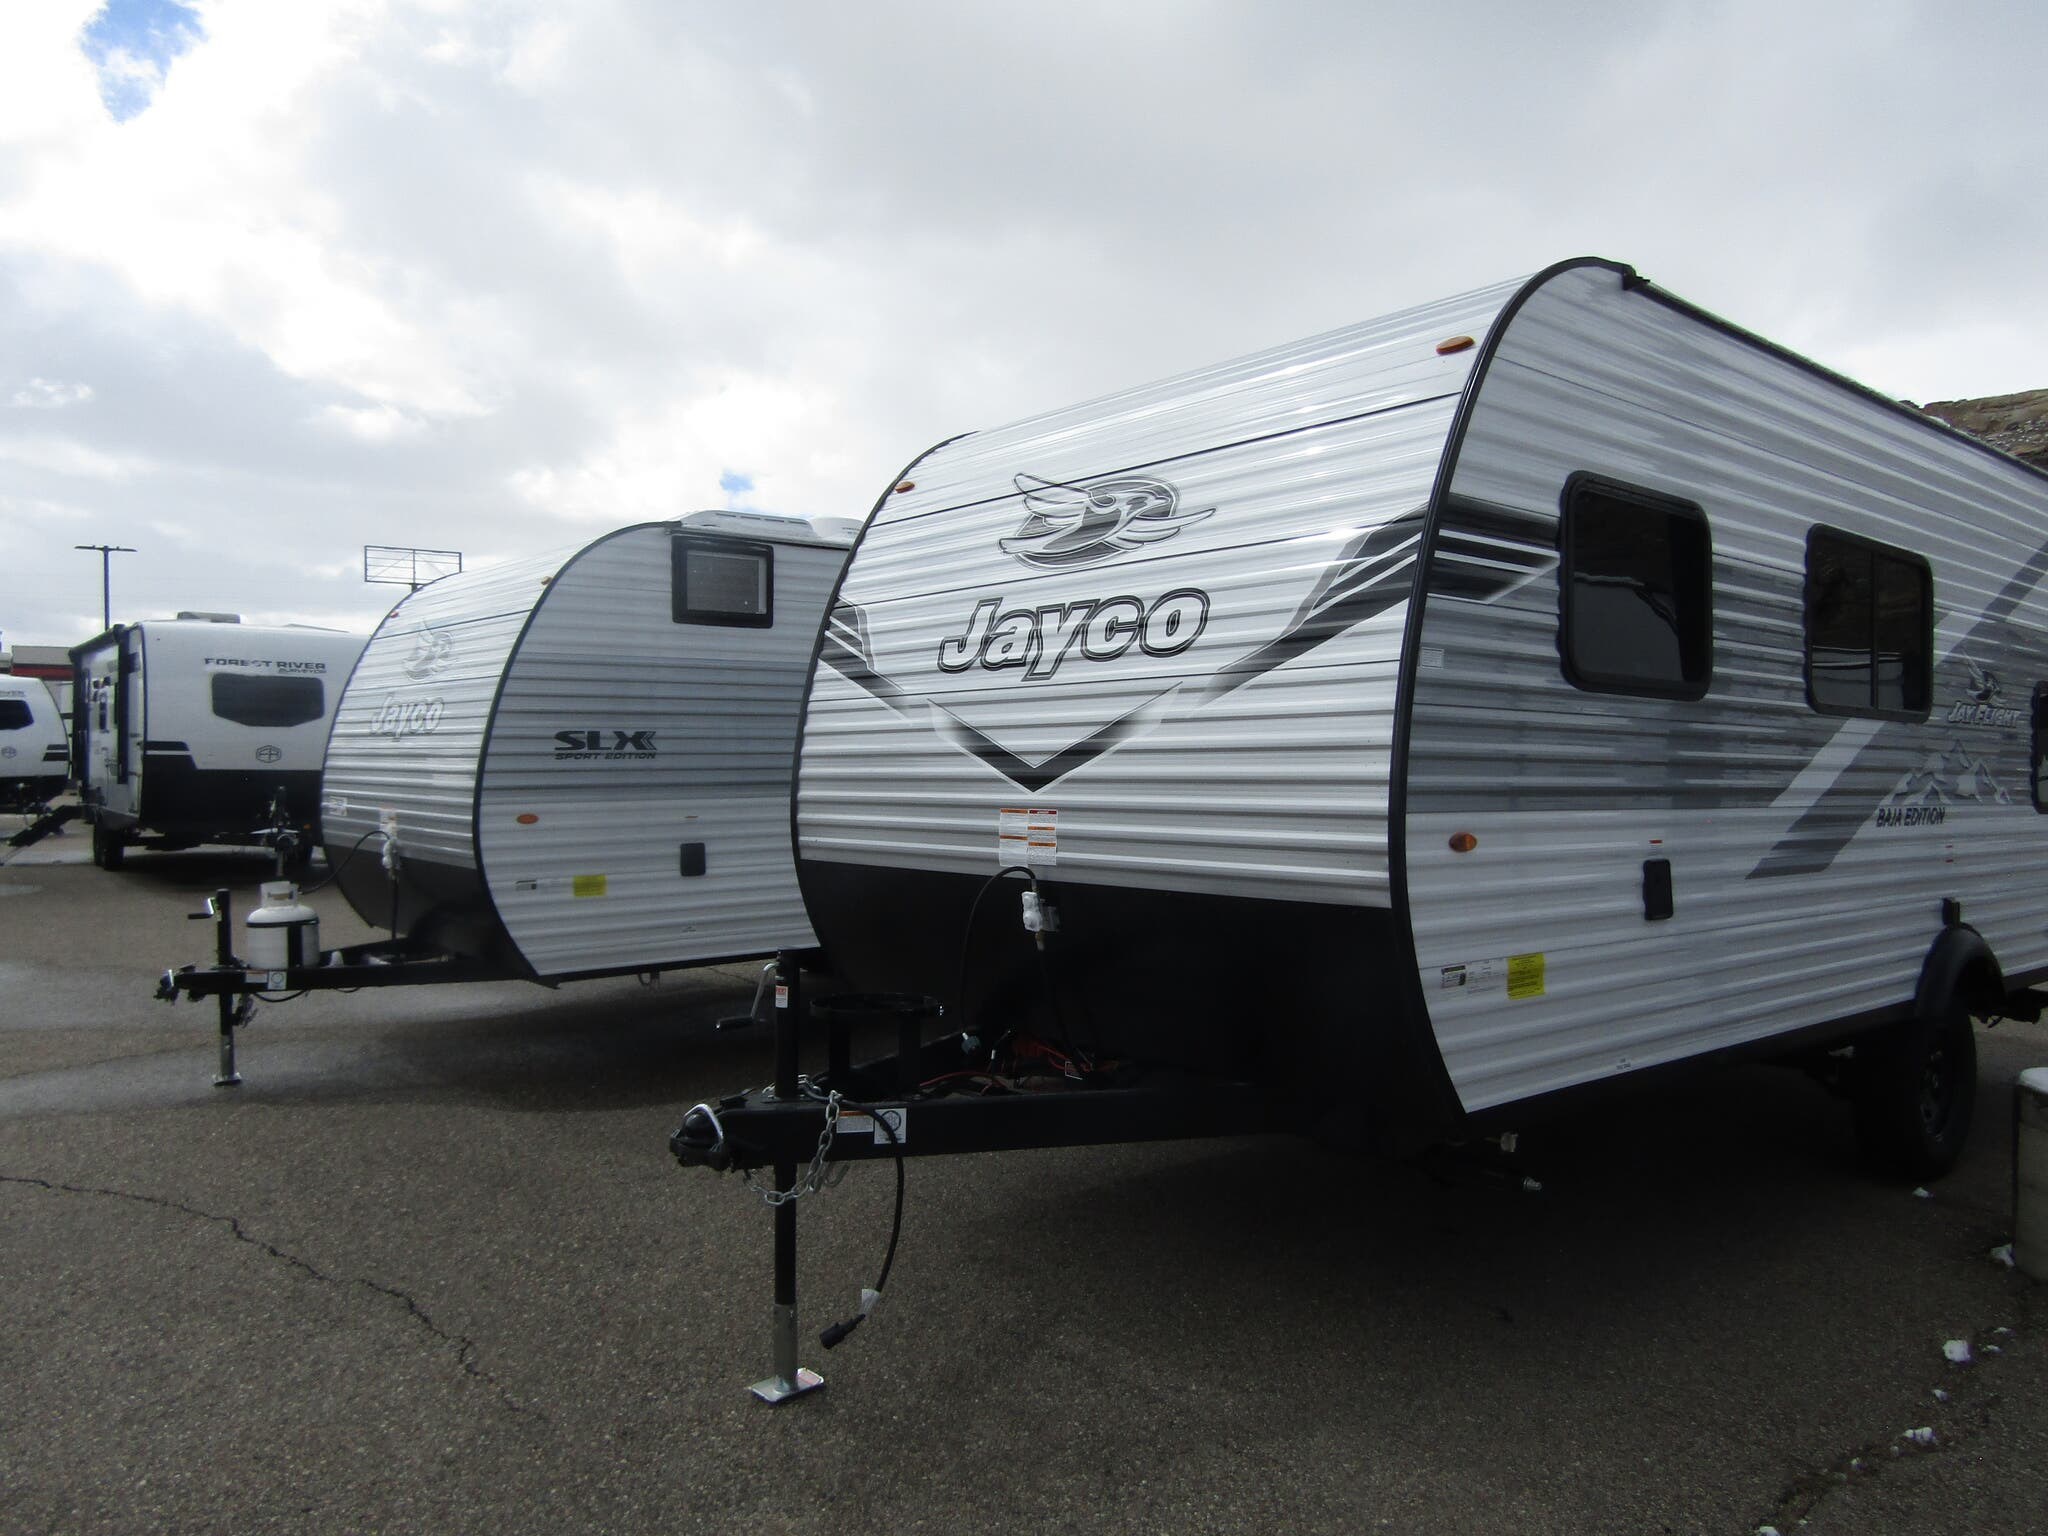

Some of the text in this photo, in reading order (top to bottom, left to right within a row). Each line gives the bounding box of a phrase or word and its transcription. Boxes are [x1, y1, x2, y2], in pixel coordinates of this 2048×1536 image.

[937, 587, 1210, 682] Jayco
[204, 658, 326, 670] FOREST RIVER
[371, 691, 445, 742] Jayco
[554, 731, 657, 750] SLX
[1876, 807, 1946, 827] BAJA EDITION
